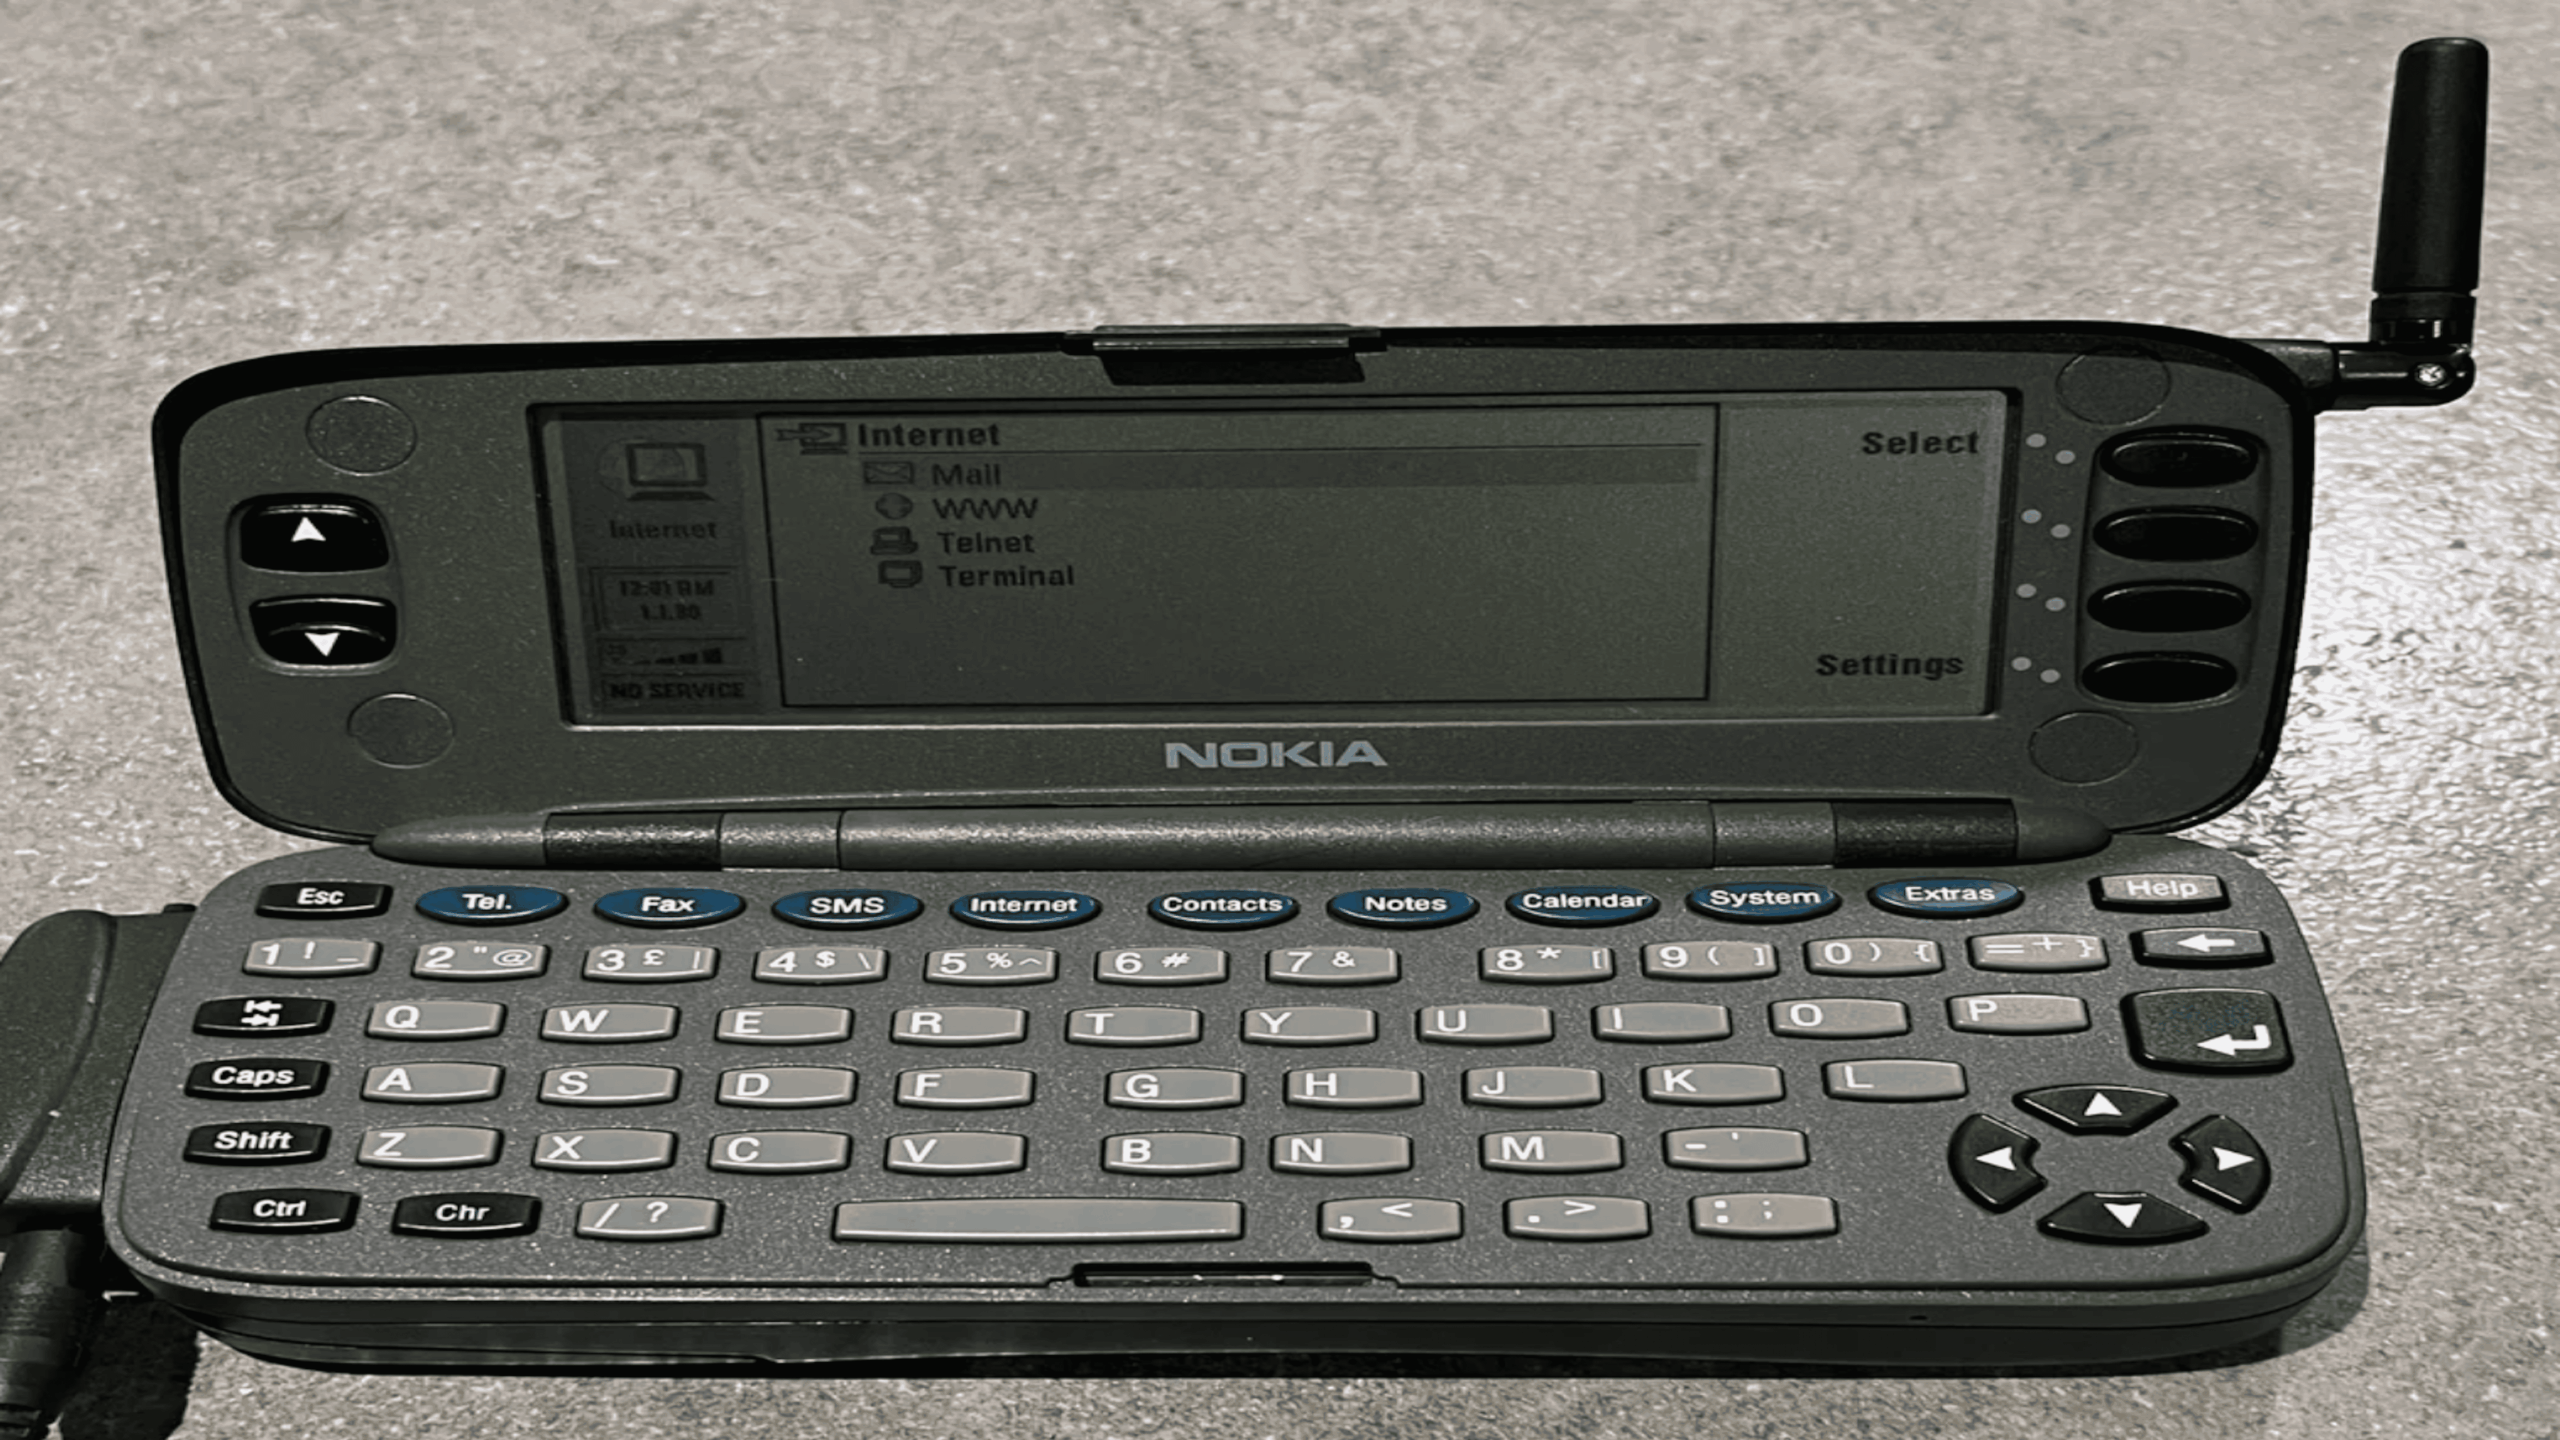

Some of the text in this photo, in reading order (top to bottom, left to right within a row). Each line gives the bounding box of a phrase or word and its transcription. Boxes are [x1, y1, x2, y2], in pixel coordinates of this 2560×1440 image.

[858, 423, 1000, 447] Internet
[1861, 430, 1979, 455] Select
[932, 464, 1001, 486] Mail
[933, 497, 1038, 519] WWW
[609, 520, 718, 539] Internet
[938, 532, 1035, 554] Telnet
[938, 565, 1074, 587] Terminal
[1815, 653, 1965, 681] Settings
[609, 682, 745, 699] NO SERVICE
[1165, 741, 1388, 768] NOKIA
[298, 888, 343, 906] Esc
[1709, 888, 1822, 908] System
[1905, 886, 1995, 903] Extras
[2127, 880, 2198, 898] Help
[462, 893, 512, 911] Tel.
[642, 896, 695, 913] Fax
[810, 897, 884, 914] SMS
[971, 897, 1078, 912] Internet
[1163, 896, 1283, 912] Contacts
[1365, 896, 1448, 912] Notes
[1522, 893, 1648, 909] Calendar
[385, 1005, 419, 1029] Q
[559, 1010, 608, 1032] W
[735, 1012, 763, 1033] E
[1258, 1011, 1291, 1033] Y
[1437, 1010, 1467, 1032] U
[1790, 1004, 1823, 1027] O
[1969, 1001, 1998, 1022] P
[911, 1012, 942, 1034] R
[1086, 1013, 1113, 1034] T
[211, 1067, 294, 1087] Caps
[377, 1069, 412, 1092] A
[557, 1072, 589, 1095] S
[736, 1074, 770, 1097] D
[915, 1074, 942, 1097] F
[1126, 1075, 1159, 1098] G
[1305, 1073, 1337, 1096] H
[1481, 1071, 1505, 1095] J
[1663, 1069, 1697, 1092] K
[1846, 1065, 1873, 1089] L
[215, 1131, 293, 1150] Shift
[373, 1133, 403, 1156] Z
[547, 1136, 584, 1159] X
[727, 1138, 759, 1161] C
[903, 1139, 939, 1162] V
[1122, 1139, 1151, 1162] B
[1290, 1138, 1323, 1161] N
[1502, 1137, 1544, 1160] M
[254, 1200, 307, 1218] Ctrl
[435, 1204, 489, 1221] Chr
